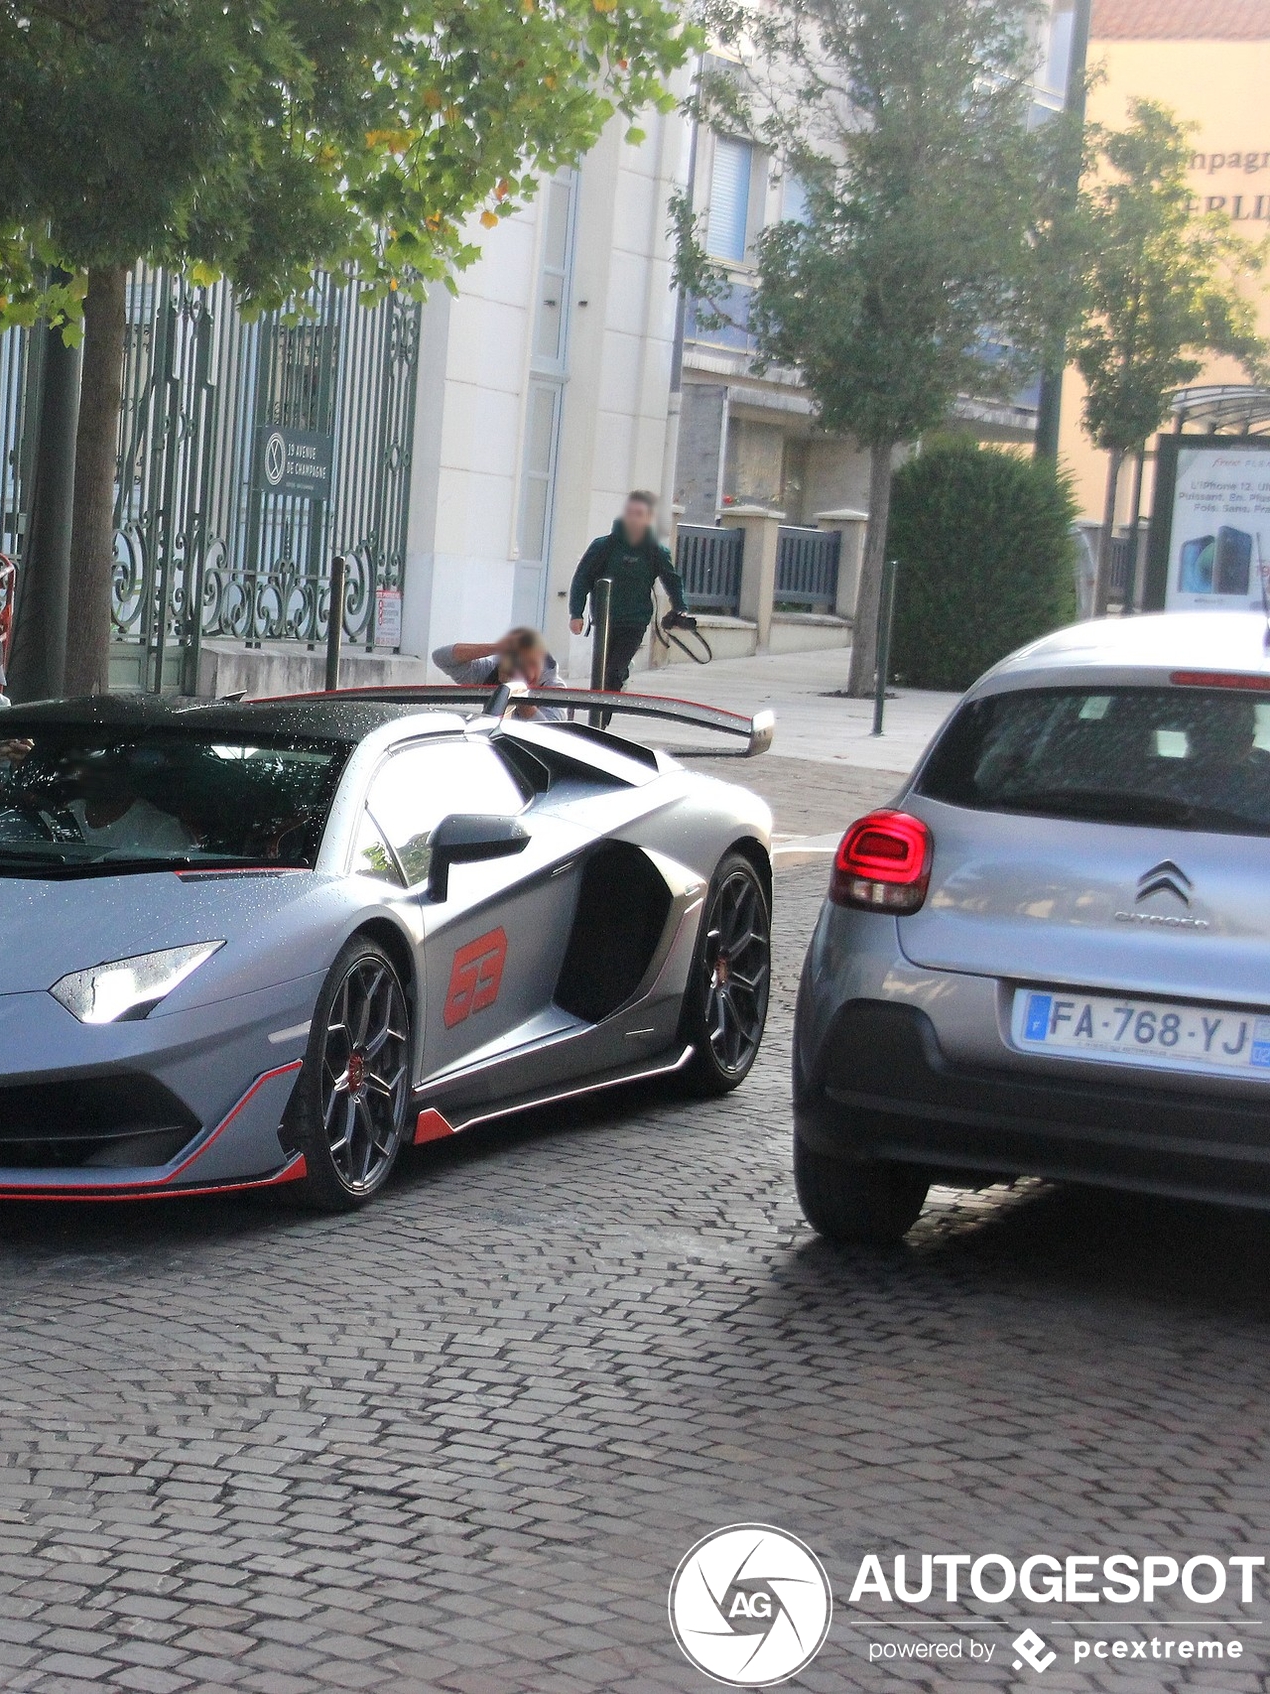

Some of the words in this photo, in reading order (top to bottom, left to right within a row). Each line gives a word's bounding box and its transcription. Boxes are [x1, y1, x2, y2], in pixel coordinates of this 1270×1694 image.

[286, 461, 294, 475] DE
[295, 462, 327, 480] CHAMPAGNE
[296, 445, 316, 460] AVENUE
[443, 925, 508, 1030] 63
[1049, 1000, 1248, 1056] FA-768-YJ
